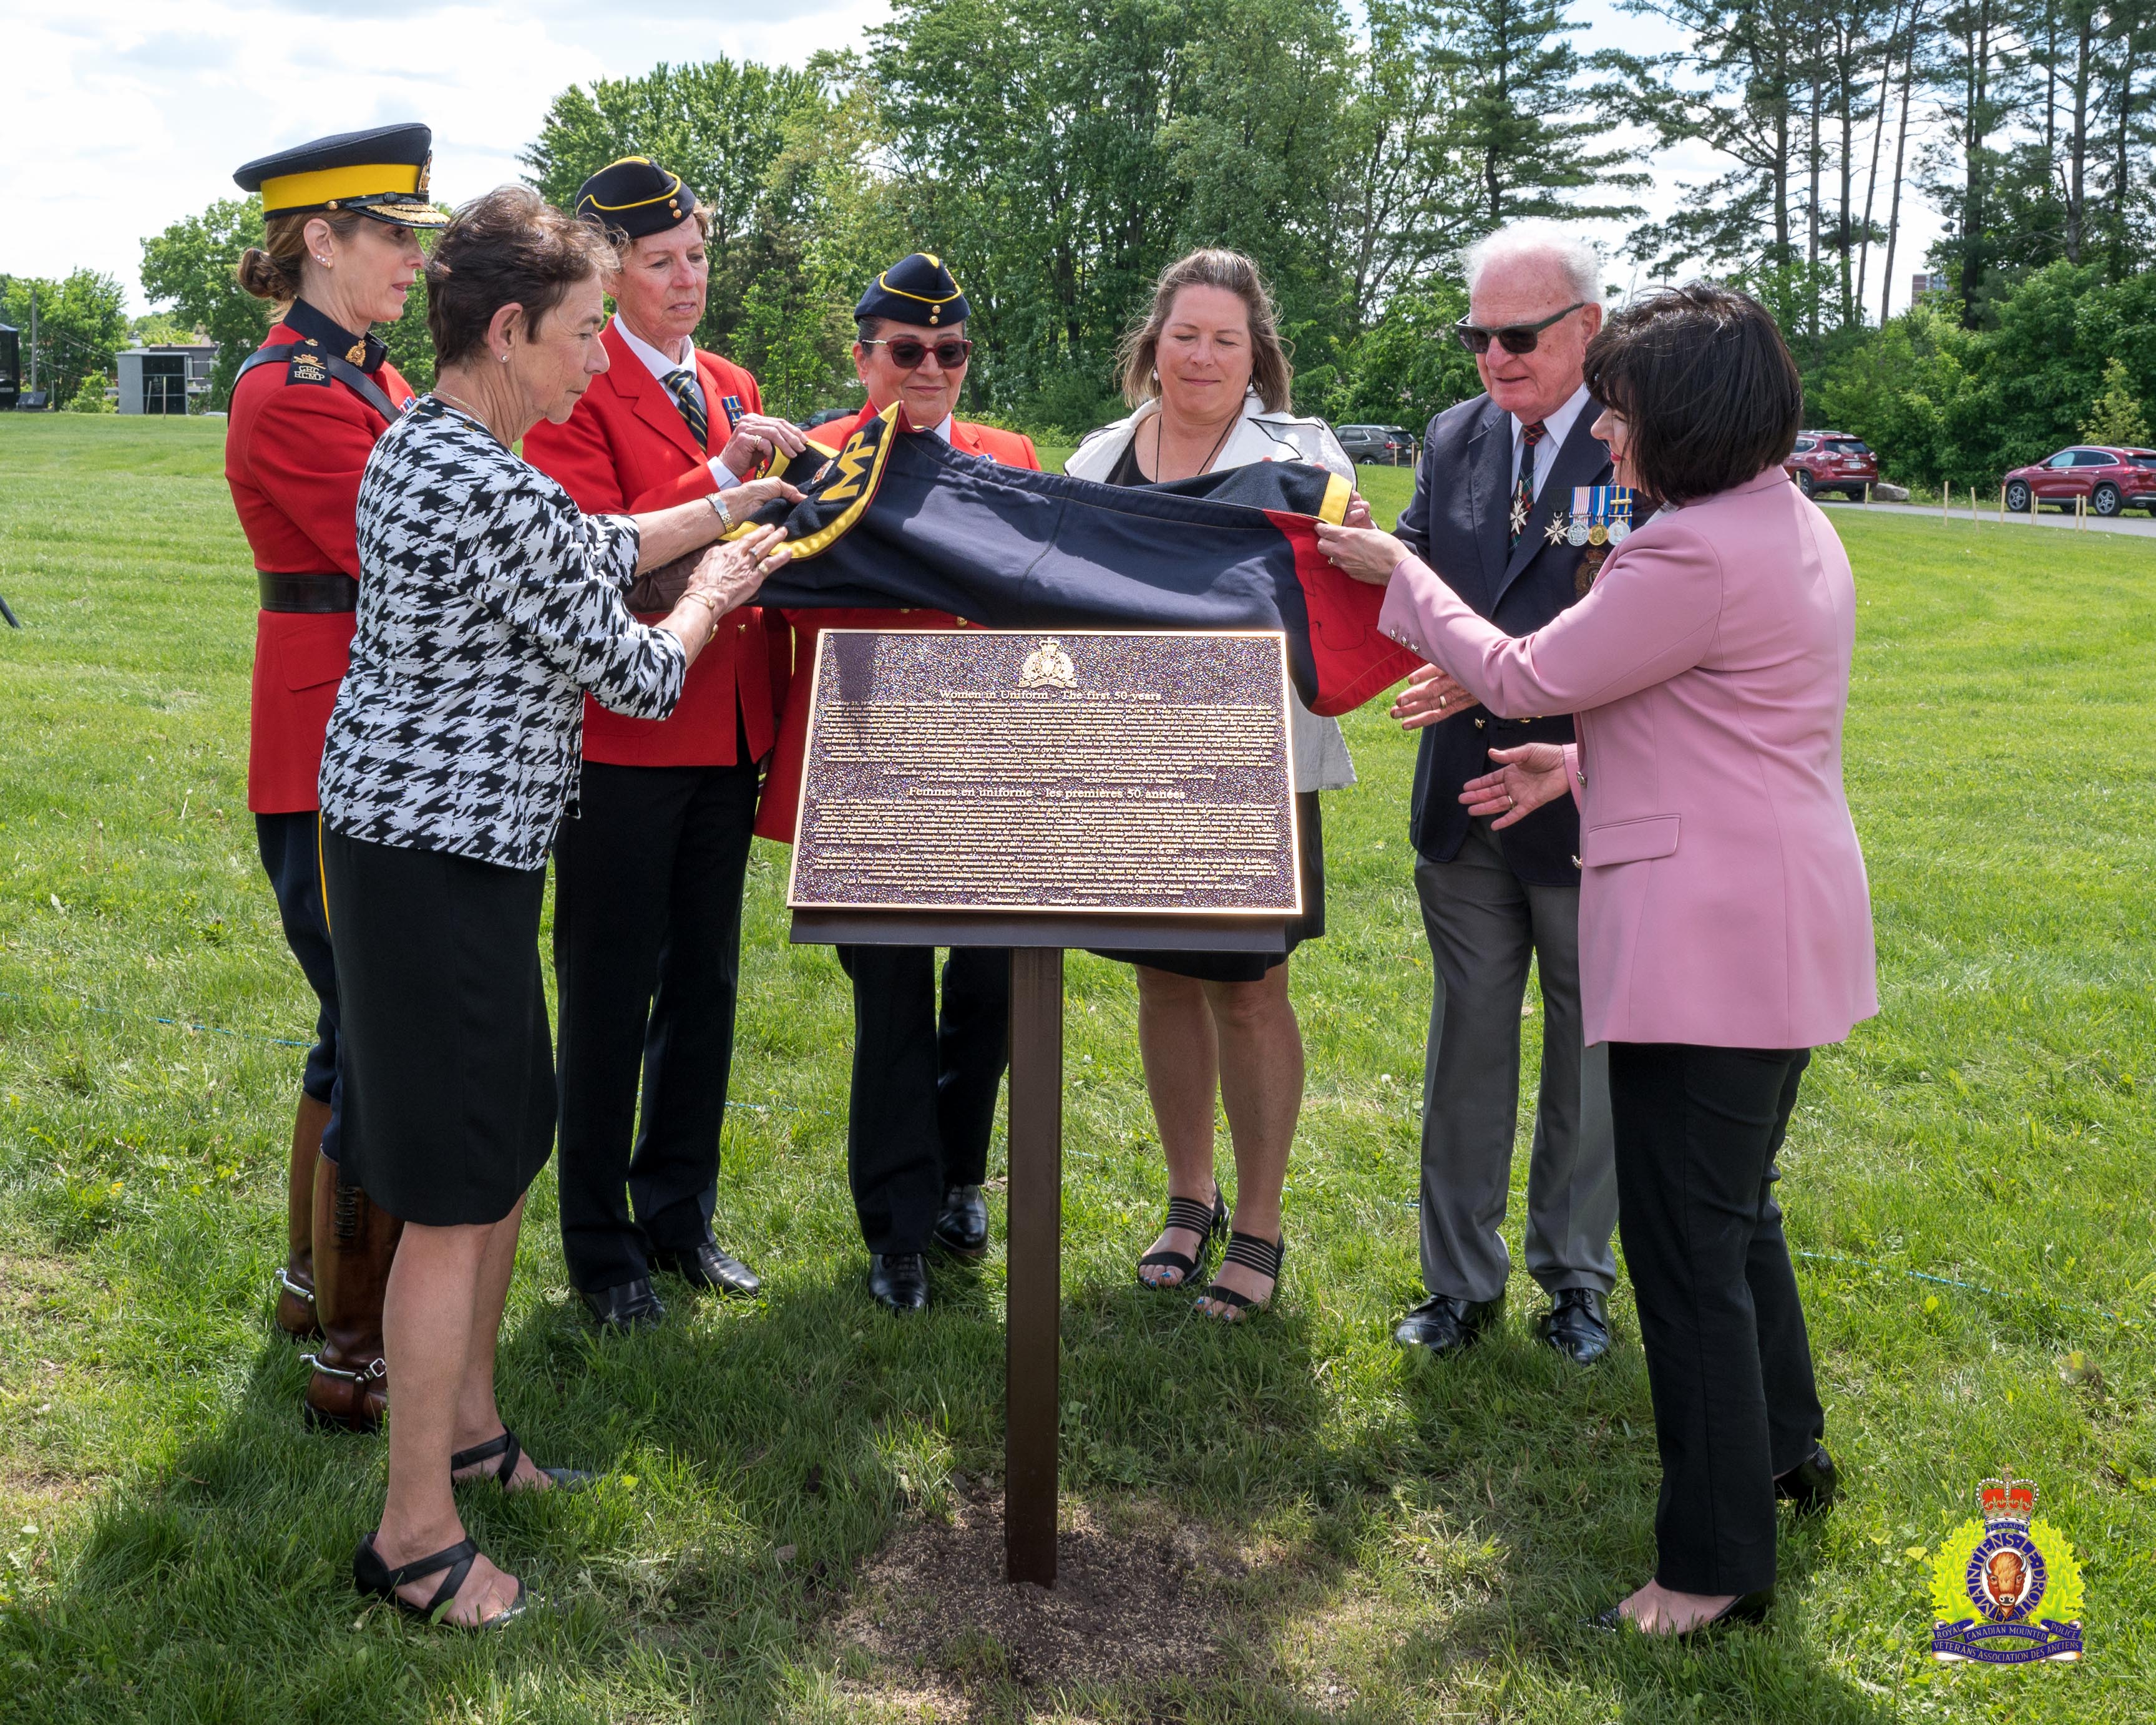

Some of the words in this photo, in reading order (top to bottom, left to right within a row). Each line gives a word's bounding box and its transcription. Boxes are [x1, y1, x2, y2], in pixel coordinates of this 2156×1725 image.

[294, 371, 325, 381] RCMP
[939, 691, 982, 700] Women
[985, 691, 996, 700] in
[1000, 691, 1048, 700] Uniform
[1061, 691, 1083, 700] The
[1086, 691, 1110, 700] first
[1113, 692, 1128, 700] 50
[1130, 693, 1161, 701] years
[908, 787, 960, 797] Femmes
[979, 788, 1033, 798] uniforme
[1045, 789, 1062, 798] les
[1065, 788, 1123, 801] premières
[1126, 789, 1141, 798] 50
[1145, 789, 1186, 799] années
